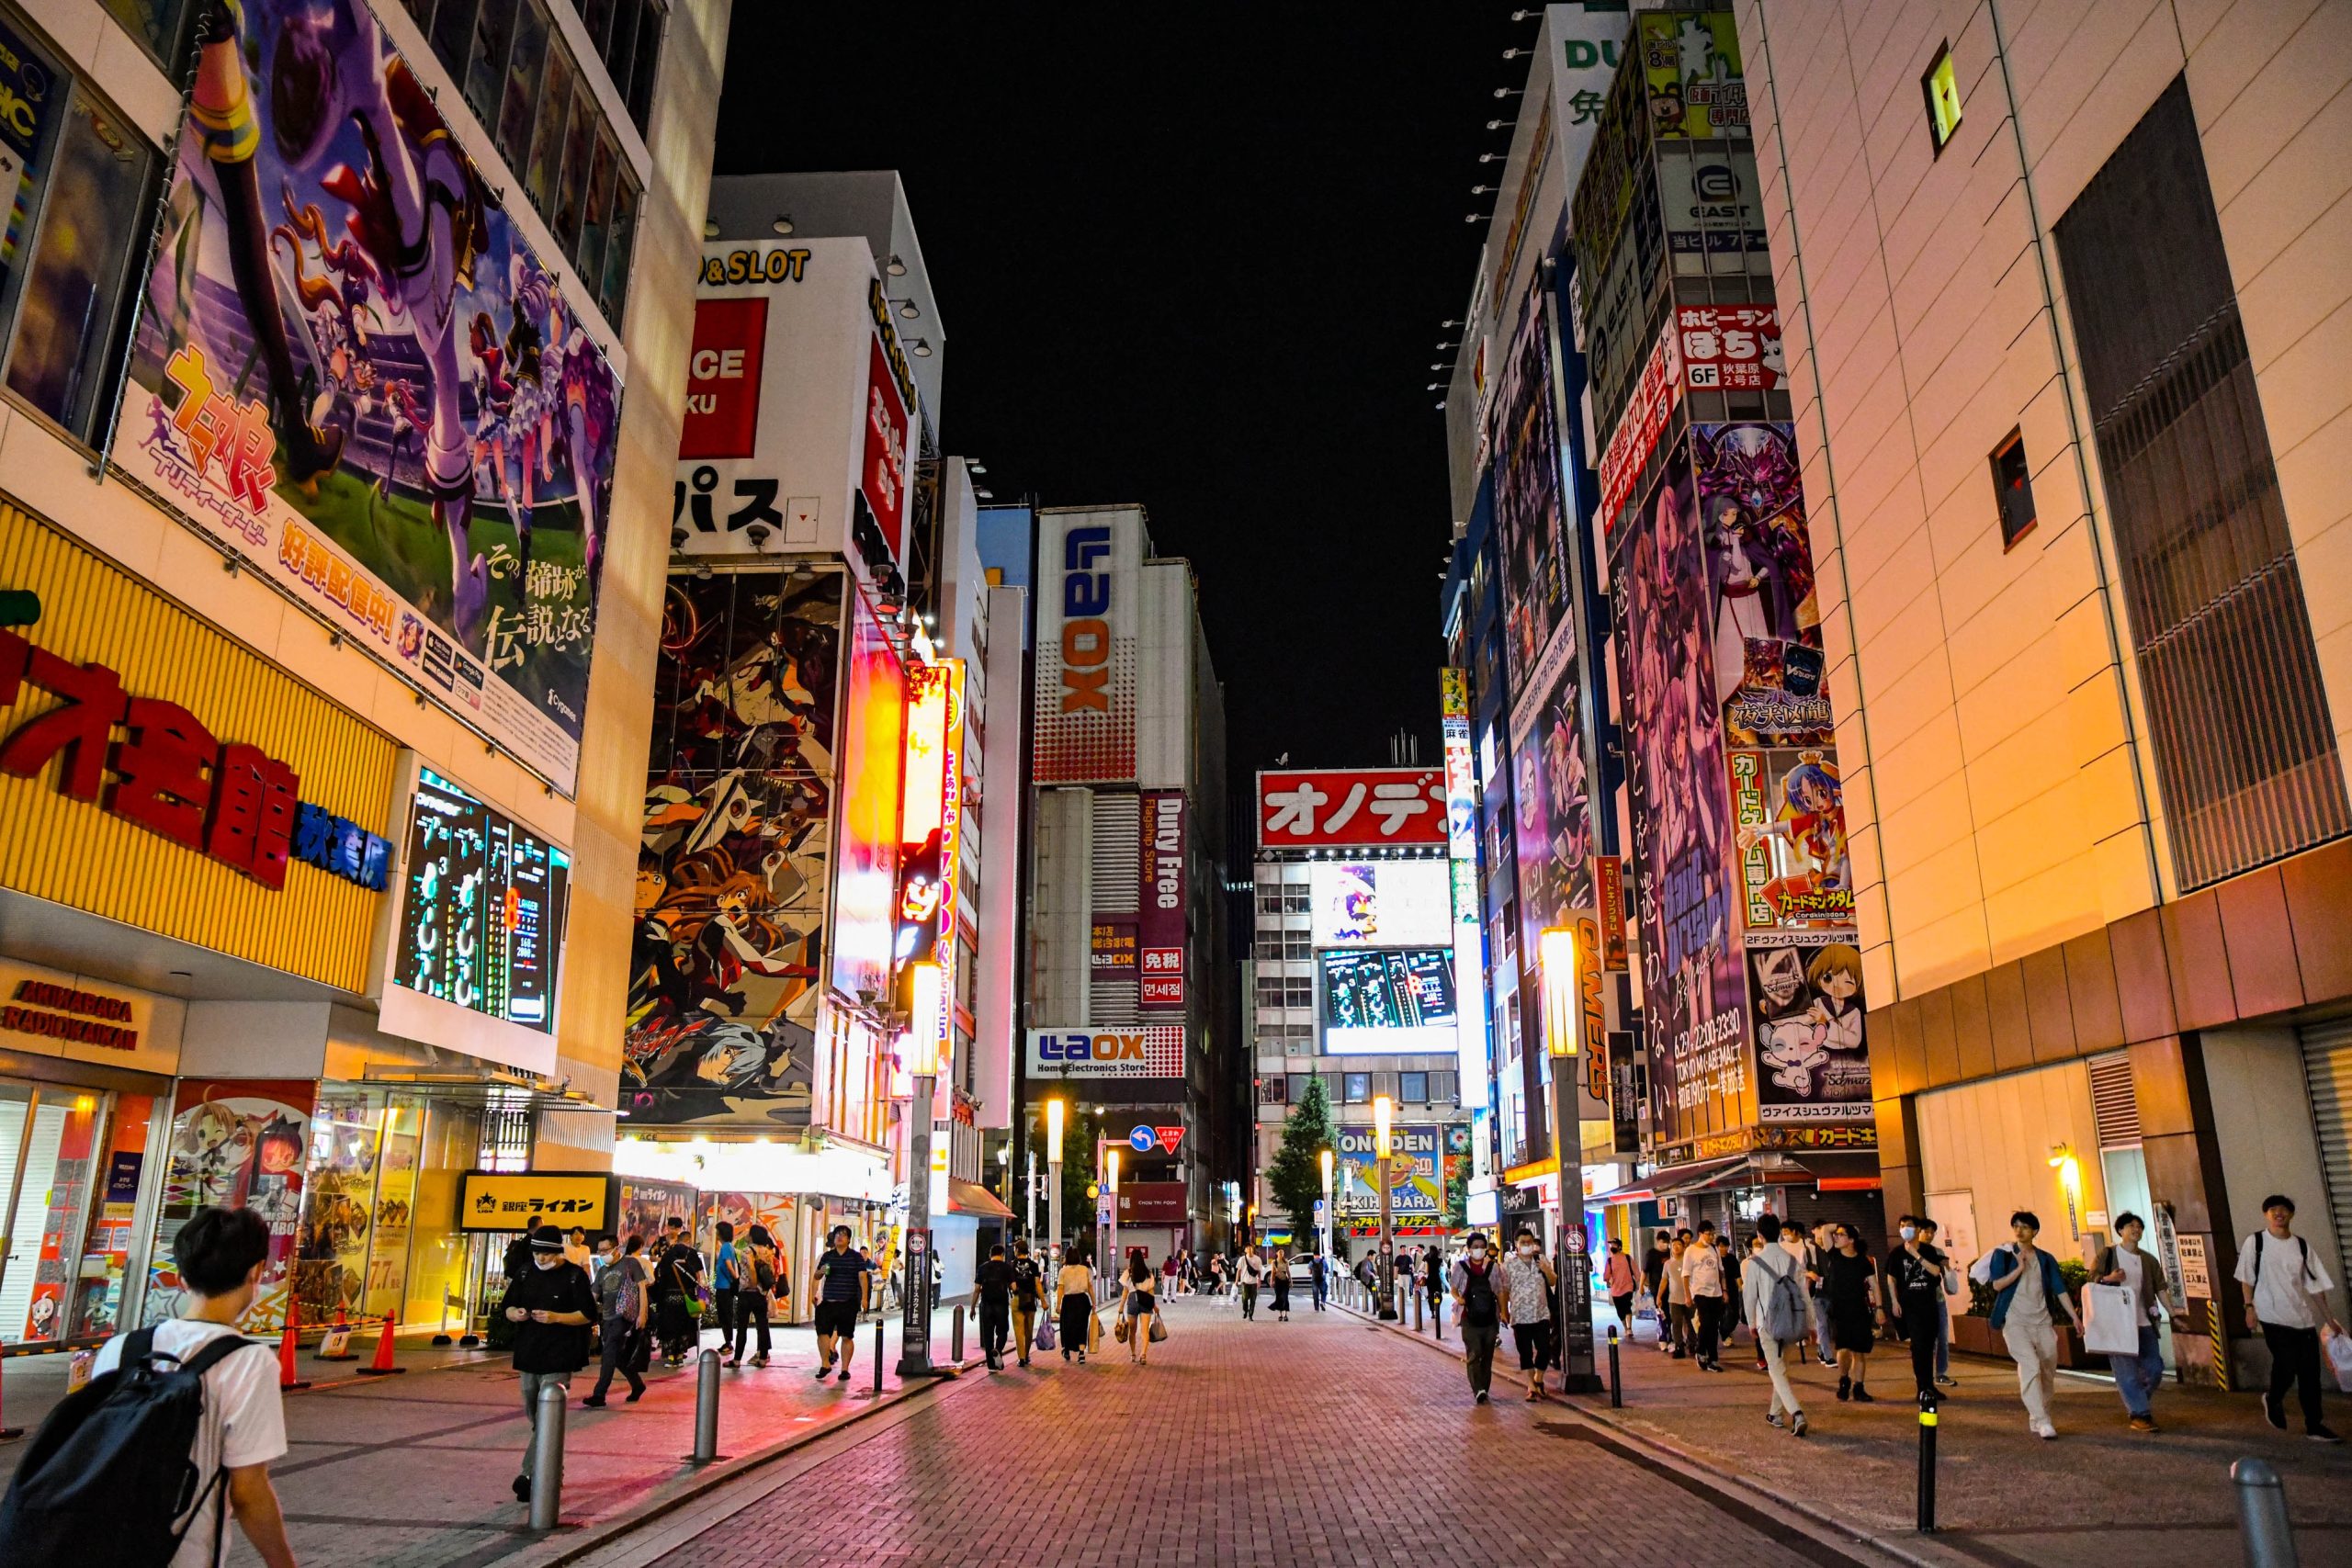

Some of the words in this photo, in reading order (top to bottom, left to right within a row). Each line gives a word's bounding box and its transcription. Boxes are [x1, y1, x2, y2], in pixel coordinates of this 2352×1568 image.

[1690, 206, 1749, 218] EAST
[1673, 235, 1723, 248] 当ビル
[689, 349, 745, 379] CE
[1723, 363, 1760, 375] 秋葉原
[1690, 368, 1716, 384] 6F
[1724, 375, 1761, 387] 2号店
[164, 344, 276, 516] ウマ娘
[149, 446, 267, 547] プリティーダービー
[278, 517, 396, 644] 好評配信中!
[553, 695, 577, 724] Cygames
[1446, 728, 1469, 739] 麻雀
[1143, 798, 1156, 847] Flagship
[1155, 798, 1182, 852] Duty
[296, 801, 392, 893] 秋葉原
[1734, 754, 1772, 924] カードゲム専門店
[438, 856, 448, 875] 3
[1145, 850, 1155, 883] Store
[1157, 856, 1182, 908] Free
[1525, 859, 1544, 901] 6.21
[1795, 910, 1847, 919] Cardkingdom
[1092, 925, 1114, 937] 本店
[1091, 937, 1136, 949] 総合家電
[1145, 953, 1181, 969] 免税
[1144, 983, 1181, 998] 면세점
[1577, 917, 1609, 1106] GAMERS
[1068, 1063, 1117, 1072] Electronics
[1120, 1063, 1146, 1072] Store
[1762, 1105, 1874, 1118] ヴァイスシュヴァルツマ
[1340, 1134, 1433, 1152] ONDEN
[503, 1198, 594, 1213] 銀座ライオン
[1340, 1195, 1436, 1210] AKIHBARA
[2181, 1248, 2203, 1258] 駐車禁止
[2186, 1275, 2208, 1284] 立入禁止
